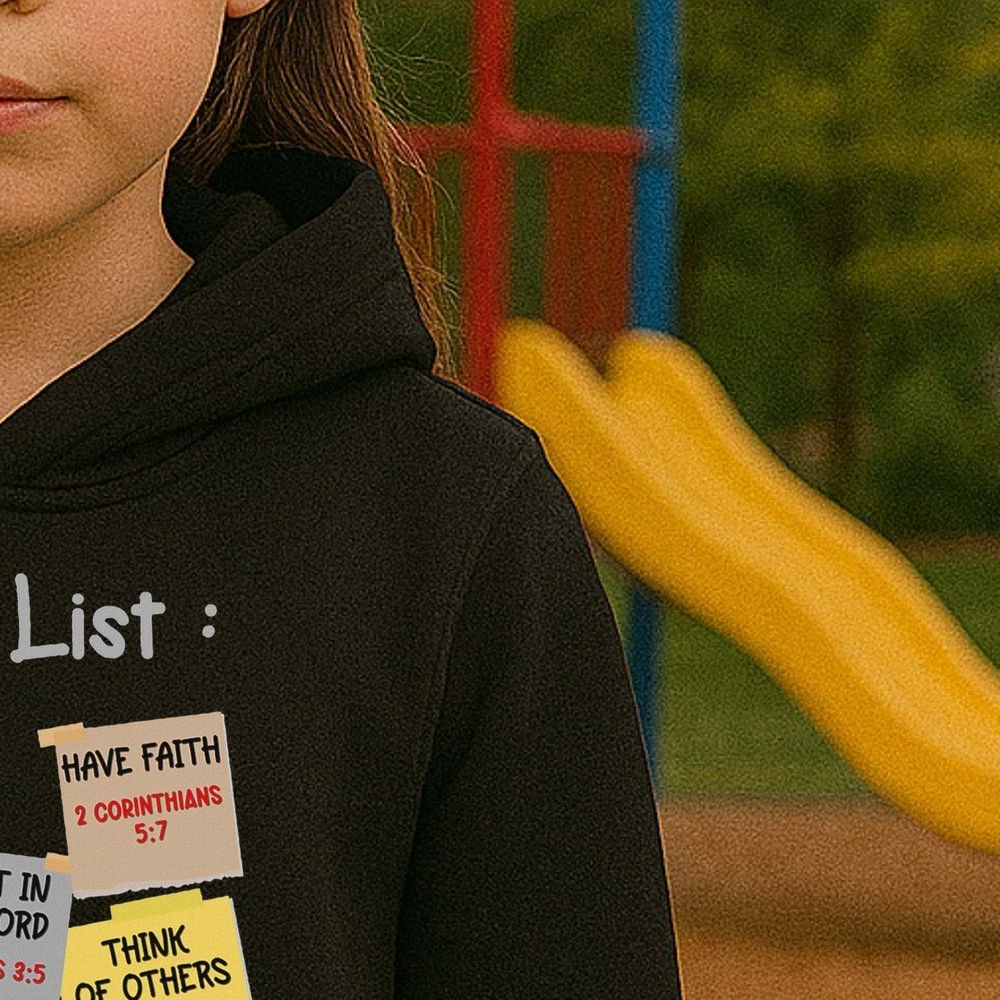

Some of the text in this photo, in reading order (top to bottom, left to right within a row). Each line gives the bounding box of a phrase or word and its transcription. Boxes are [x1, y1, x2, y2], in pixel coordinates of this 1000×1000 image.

[10, 573, 166, 663] List
[61, 735, 221, 783] HAVE FAITH
[74, 784, 223, 826] 2 CORINTHIANS
[135, 820, 168, 844] 5:7
[20, 872, 51, 903] IN
[101, 925, 190, 967] THINK
[13, 960, 47, 985] 3:5
